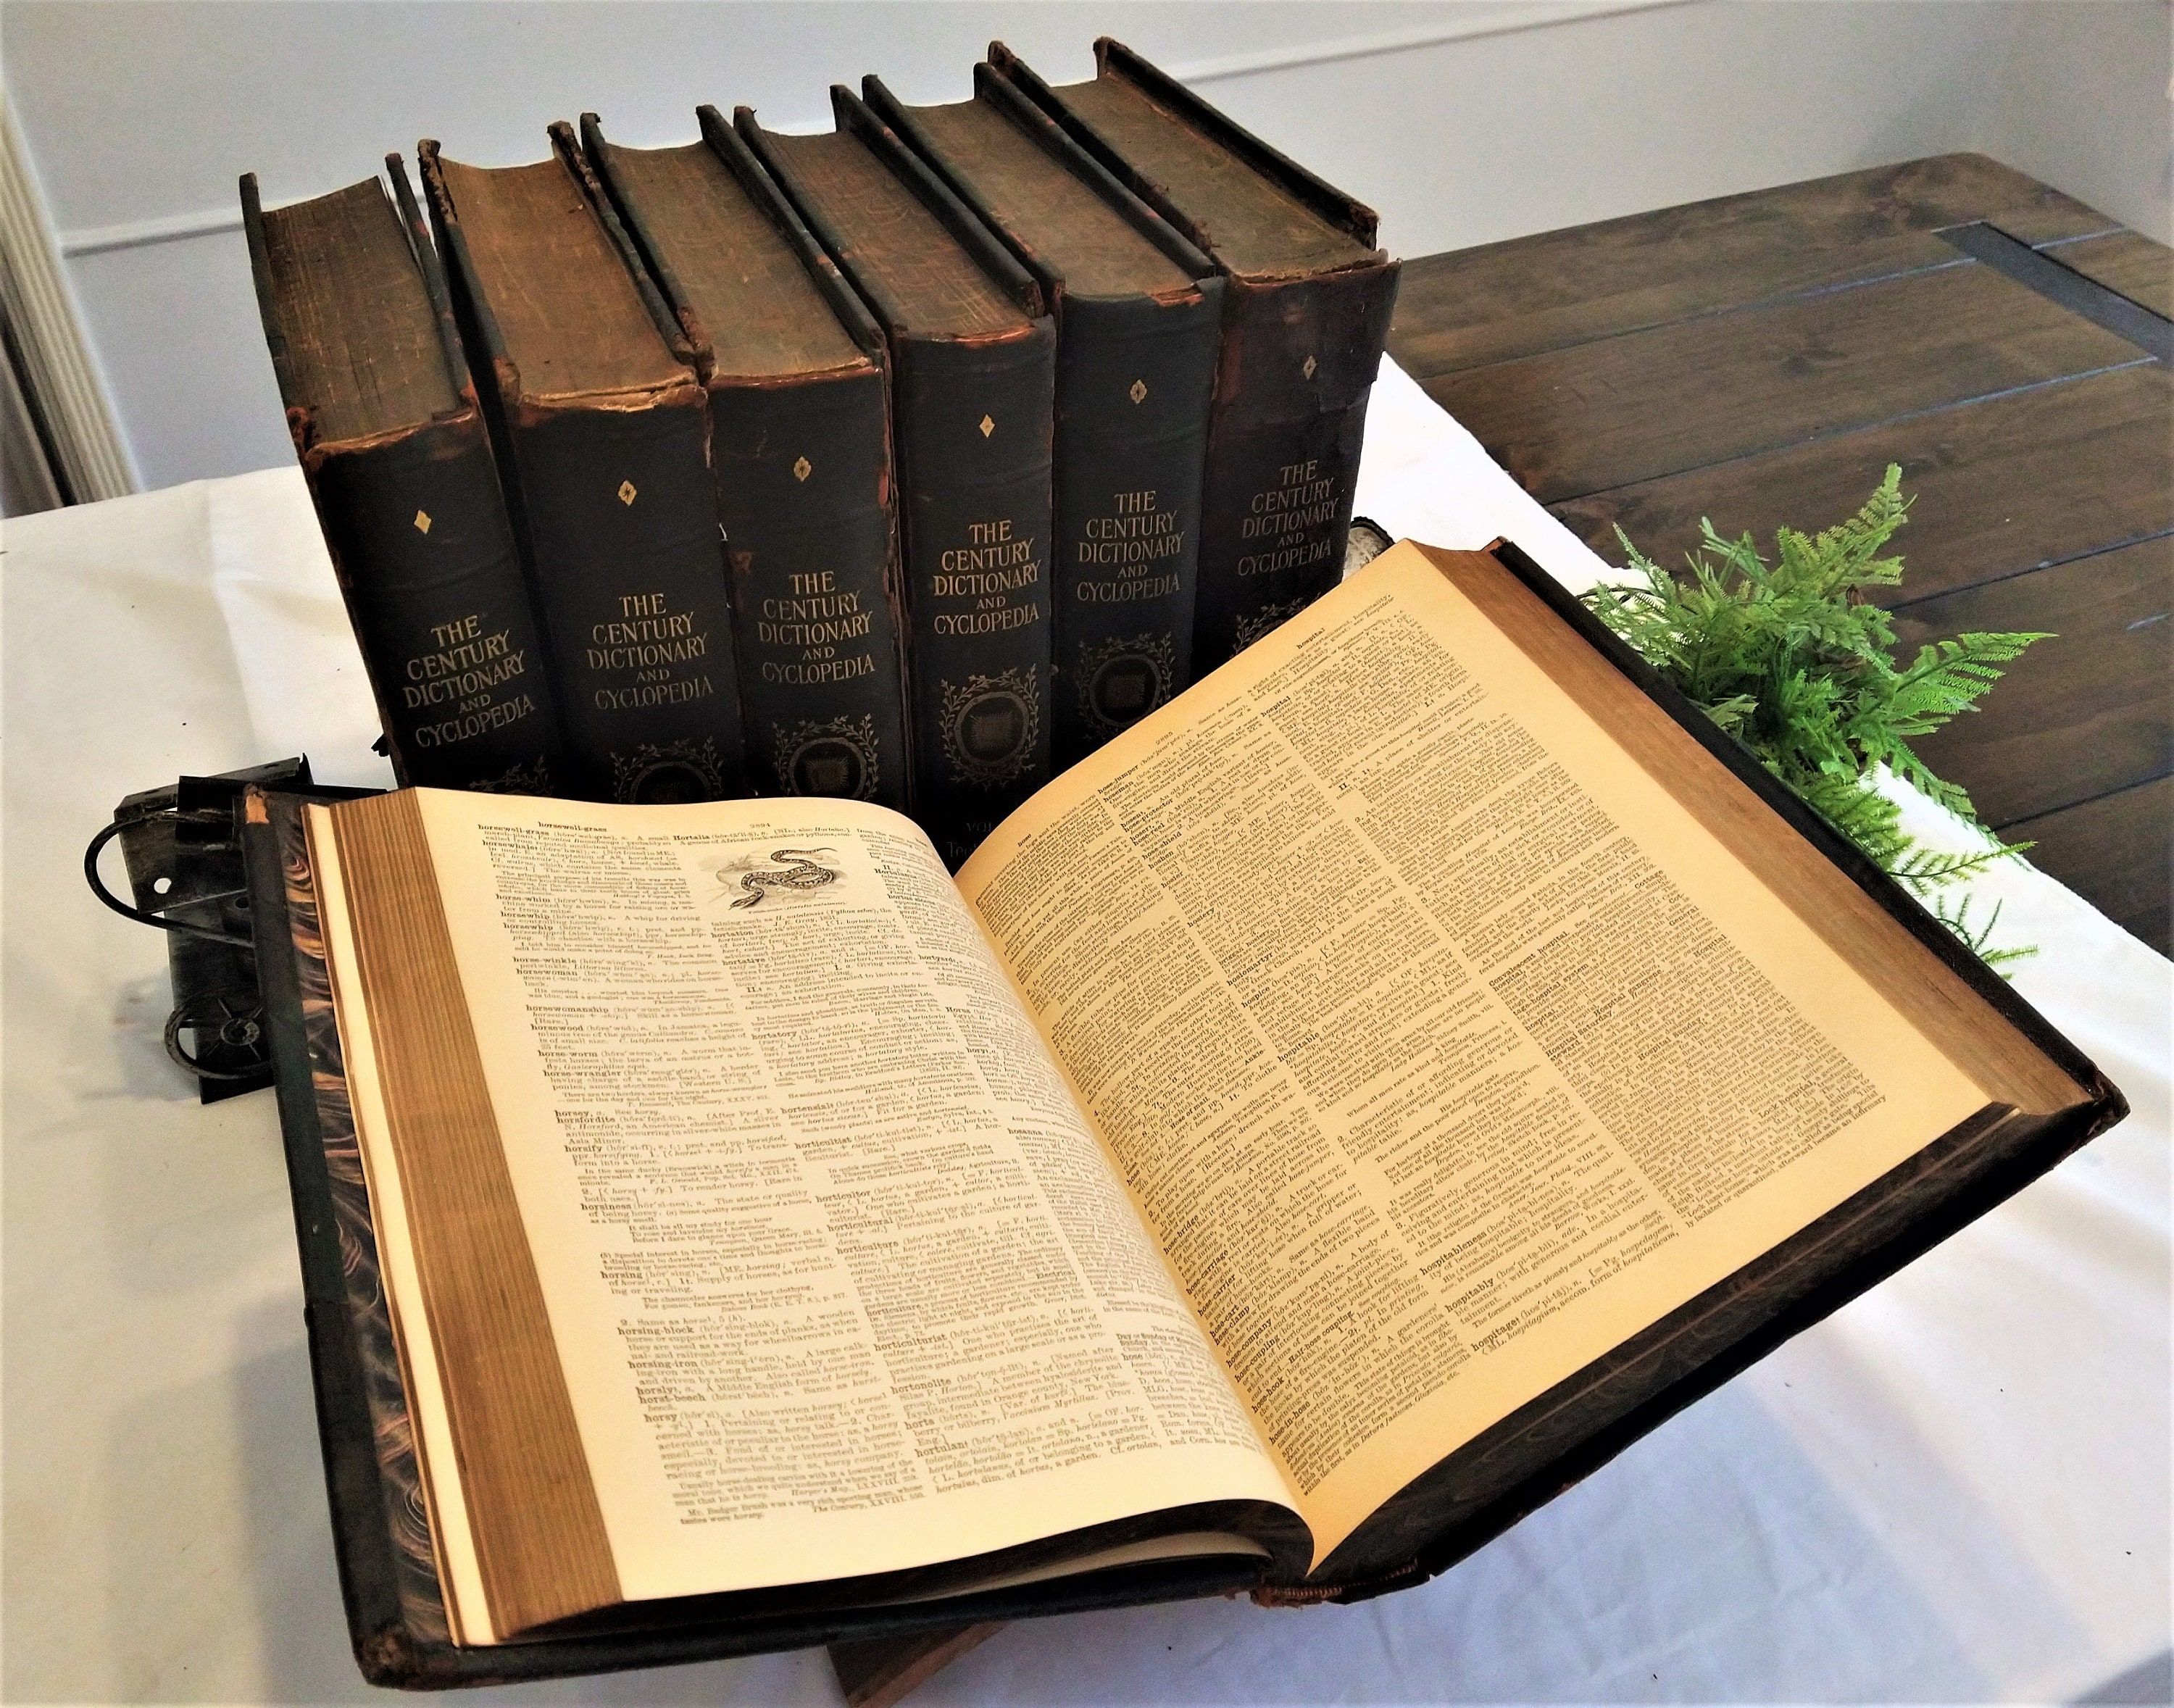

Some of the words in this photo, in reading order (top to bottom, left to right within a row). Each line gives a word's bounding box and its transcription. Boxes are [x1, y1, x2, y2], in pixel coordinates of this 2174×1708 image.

[1280, 460, 1317, 486] THE
[1115, 491, 1156, 513] THE
[1251, 478, 1334, 514] CENTURY
[970, 520, 1012, 543] THE
[1086, 511, 1177, 538] CENTURY
[1242, 499, 1339, 538] DICTIONARY
[942, 538, 1033, 571] CENTURY
[1078, 532, 1184, 563] DICTIONARY
[1278, 533, 1304, 547] AND
[1117, 565, 1147, 578] AND
[1238, 538, 1330, 576] CYCLOPEDIA
[789, 571, 836, 594] THE
[933, 560, 1041, 596] DICTIONARY
[1077, 574, 1181, 601] CYCLOPEDIA
[619, 593, 666, 617] THE
[764, 591, 861, 620] CENTURY
[976, 596, 1006, 609] AND
[431, 615, 481, 647] THE
[593, 612, 694, 643] CENTURY
[758, 612, 873, 644] DICTIONARY
[934, 604, 1039, 635] CYCLOPEDIA
[407, 629, 509, 680] CENTURY
[588, 633, 707, 670] DICTIONARY
[802, 646, 835, 659] AND
[402, 651, 525, 708] DICTIONARY
[636, 669, 670, 682] AND
[763, 654, 875, 683] CYCLOPEDIA
[459, 693, 491, 714] AND
[595, 678, 713, 710] CYCLOPEDIA
[416, 693, 536, 749] CYCLOPEDIA
